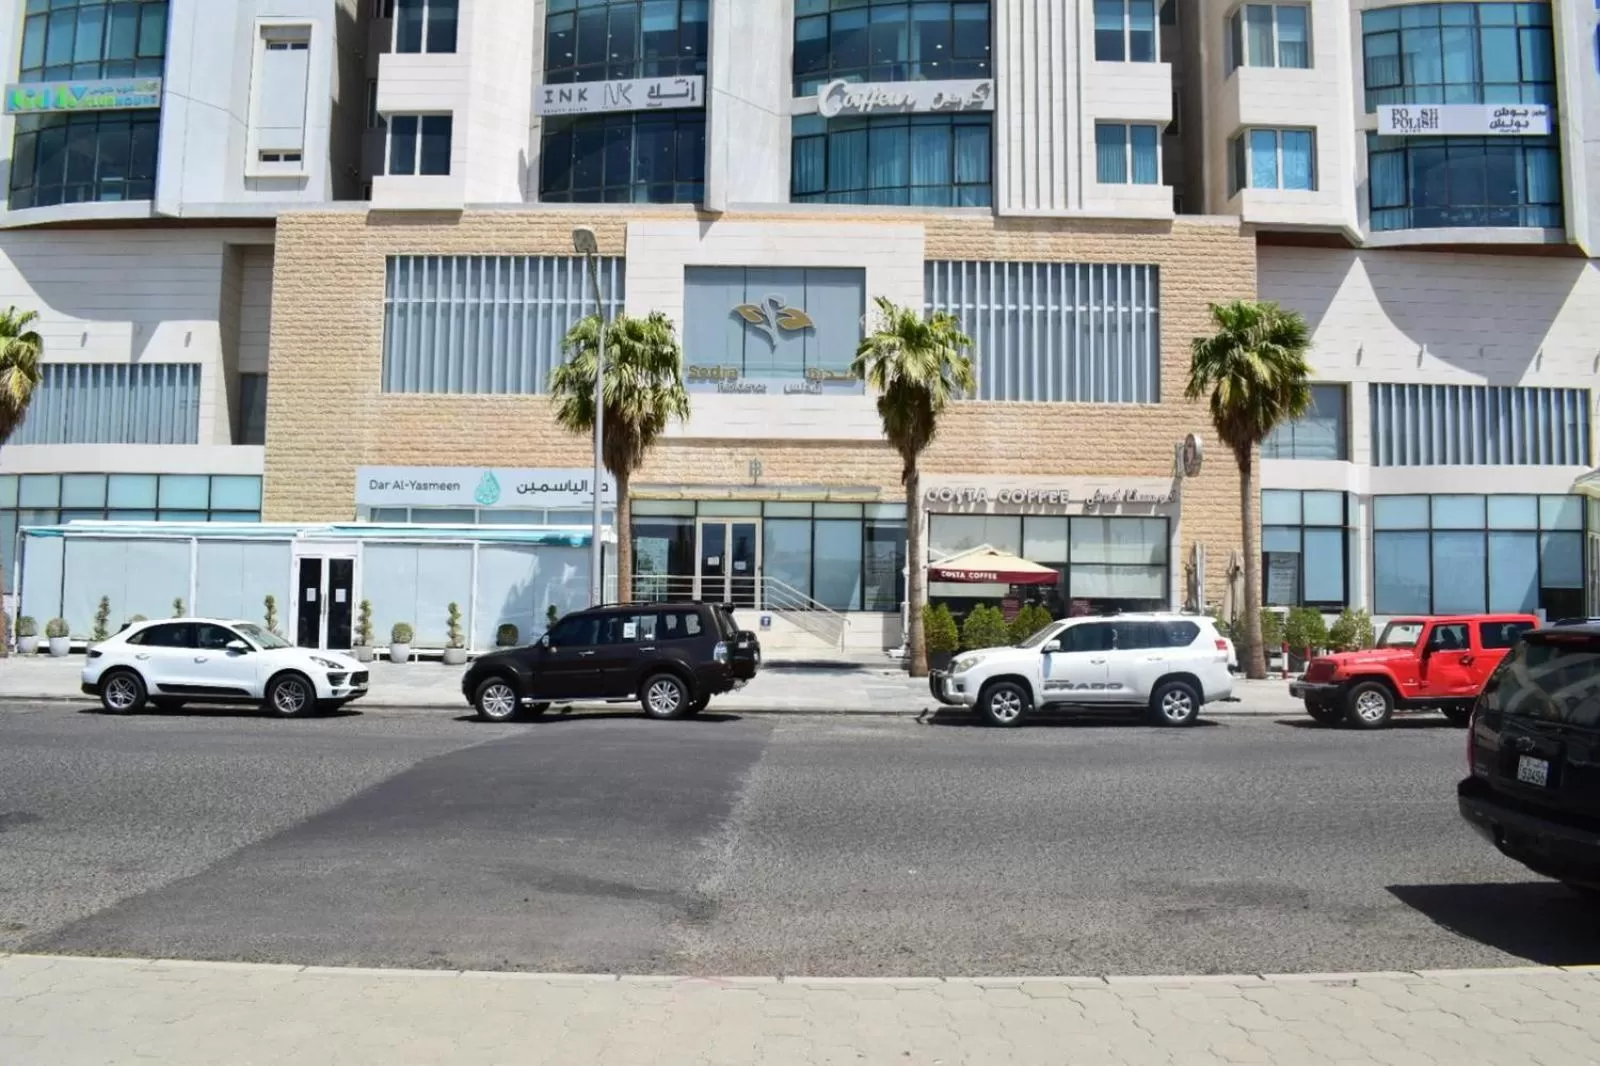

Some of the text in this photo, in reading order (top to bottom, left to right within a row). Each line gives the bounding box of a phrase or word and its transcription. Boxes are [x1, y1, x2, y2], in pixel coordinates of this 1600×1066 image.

[544, 87, 588, 104] INK
[369, 479, 391, 490] Dar
[516, 479, 588, 494] الياسمين
[926, 487, 1069, 504] COSTA COFFEE
[940, 570, 998, 581] COSTA COFFEE
[1043, 682, 1123, 690] PRADO
